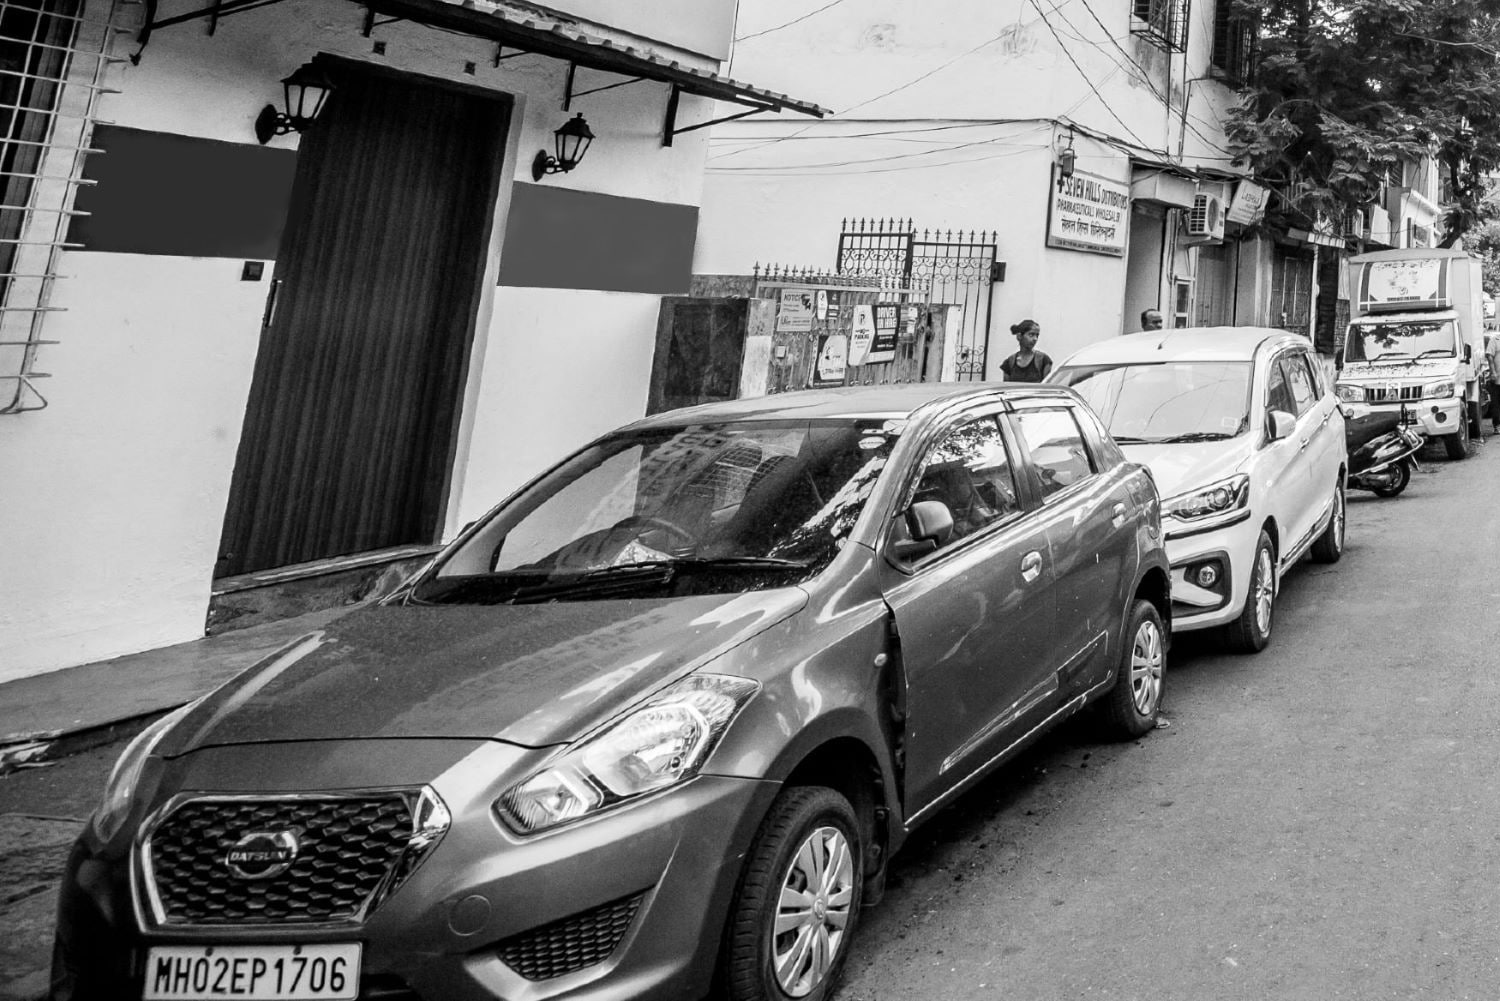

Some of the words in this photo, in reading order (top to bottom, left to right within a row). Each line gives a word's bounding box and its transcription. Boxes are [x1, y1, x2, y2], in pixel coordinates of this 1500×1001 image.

[1064, 176, 1085, 199] SEVEN
[1085, 179, 1101, 204] HILLS
[229, 850, 287, 862] DATSUN
[153, 956, 348, 995] MH02EP1706
